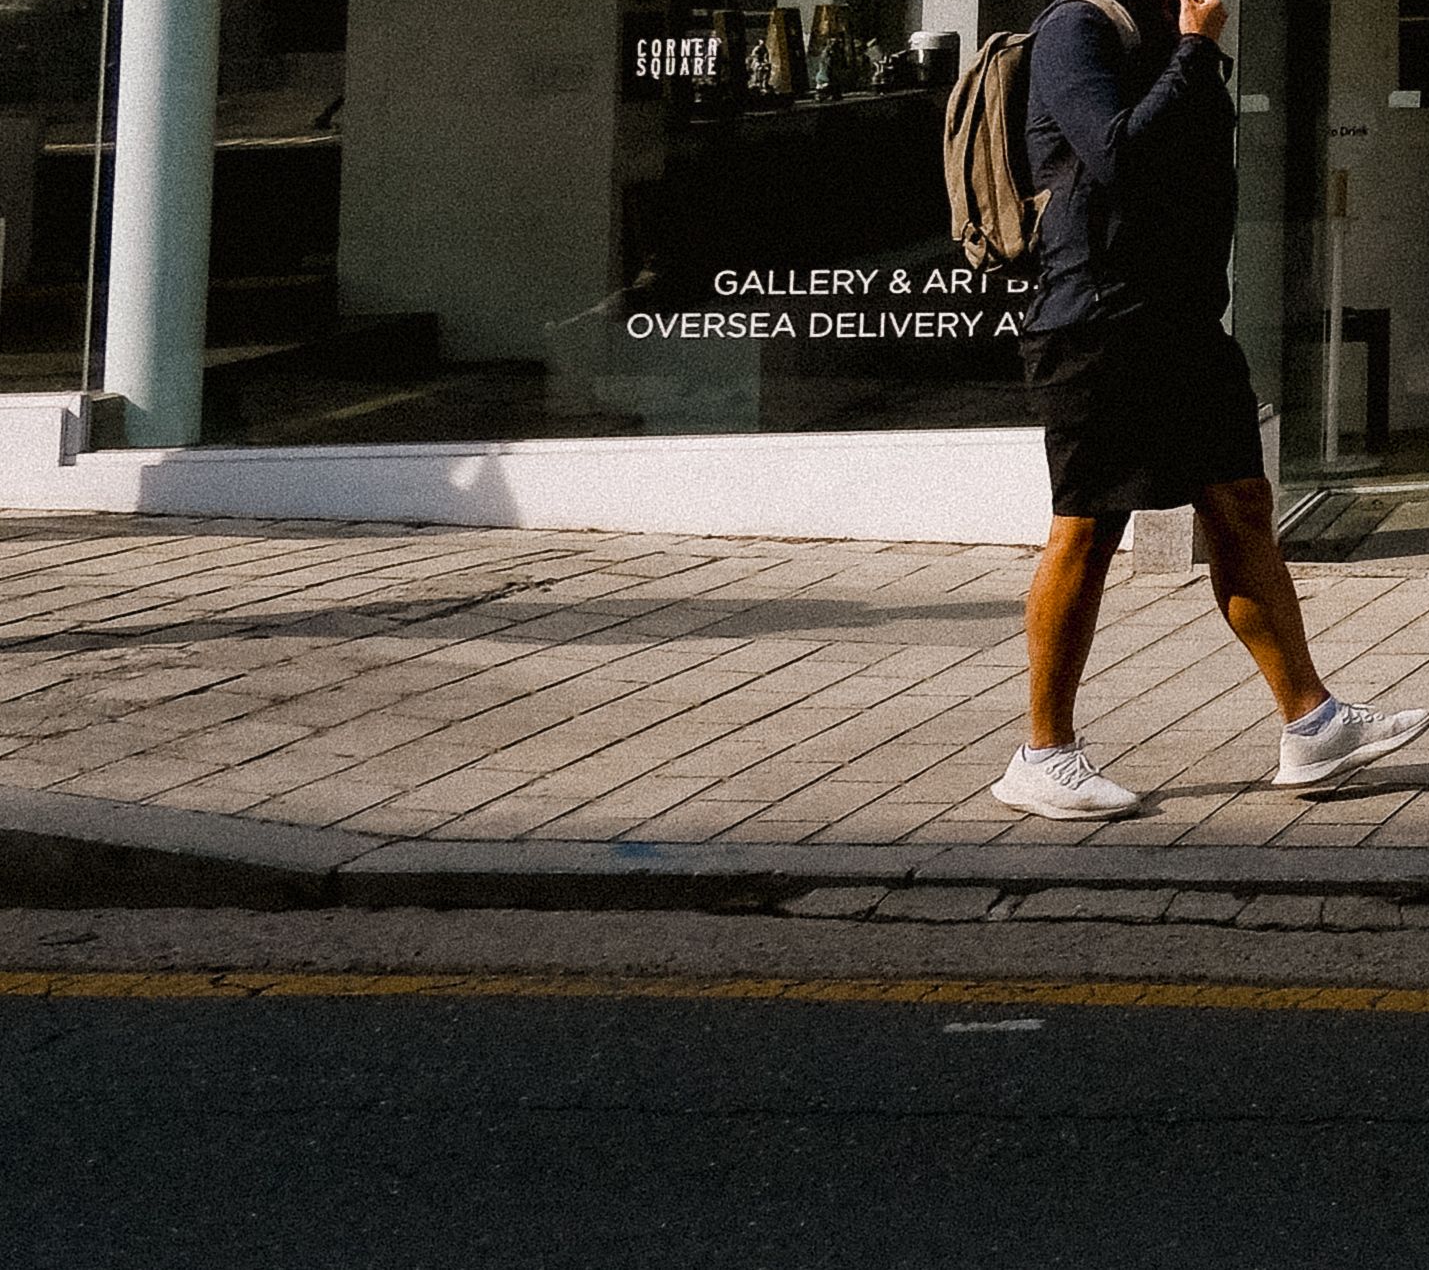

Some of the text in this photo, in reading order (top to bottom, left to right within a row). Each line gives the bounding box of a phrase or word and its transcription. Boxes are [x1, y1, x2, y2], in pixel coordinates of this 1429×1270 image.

[637, 37, 717, 57] CORNER
[636, 56, 717, 80] SQUARE
[1340, 125, 1368, 137] Drink
[713, 268, 879, 296] GALLERY
[888, 268, 912, 294] &
[626, 310, 1025, 339] OVERSEA DELIVERY A
